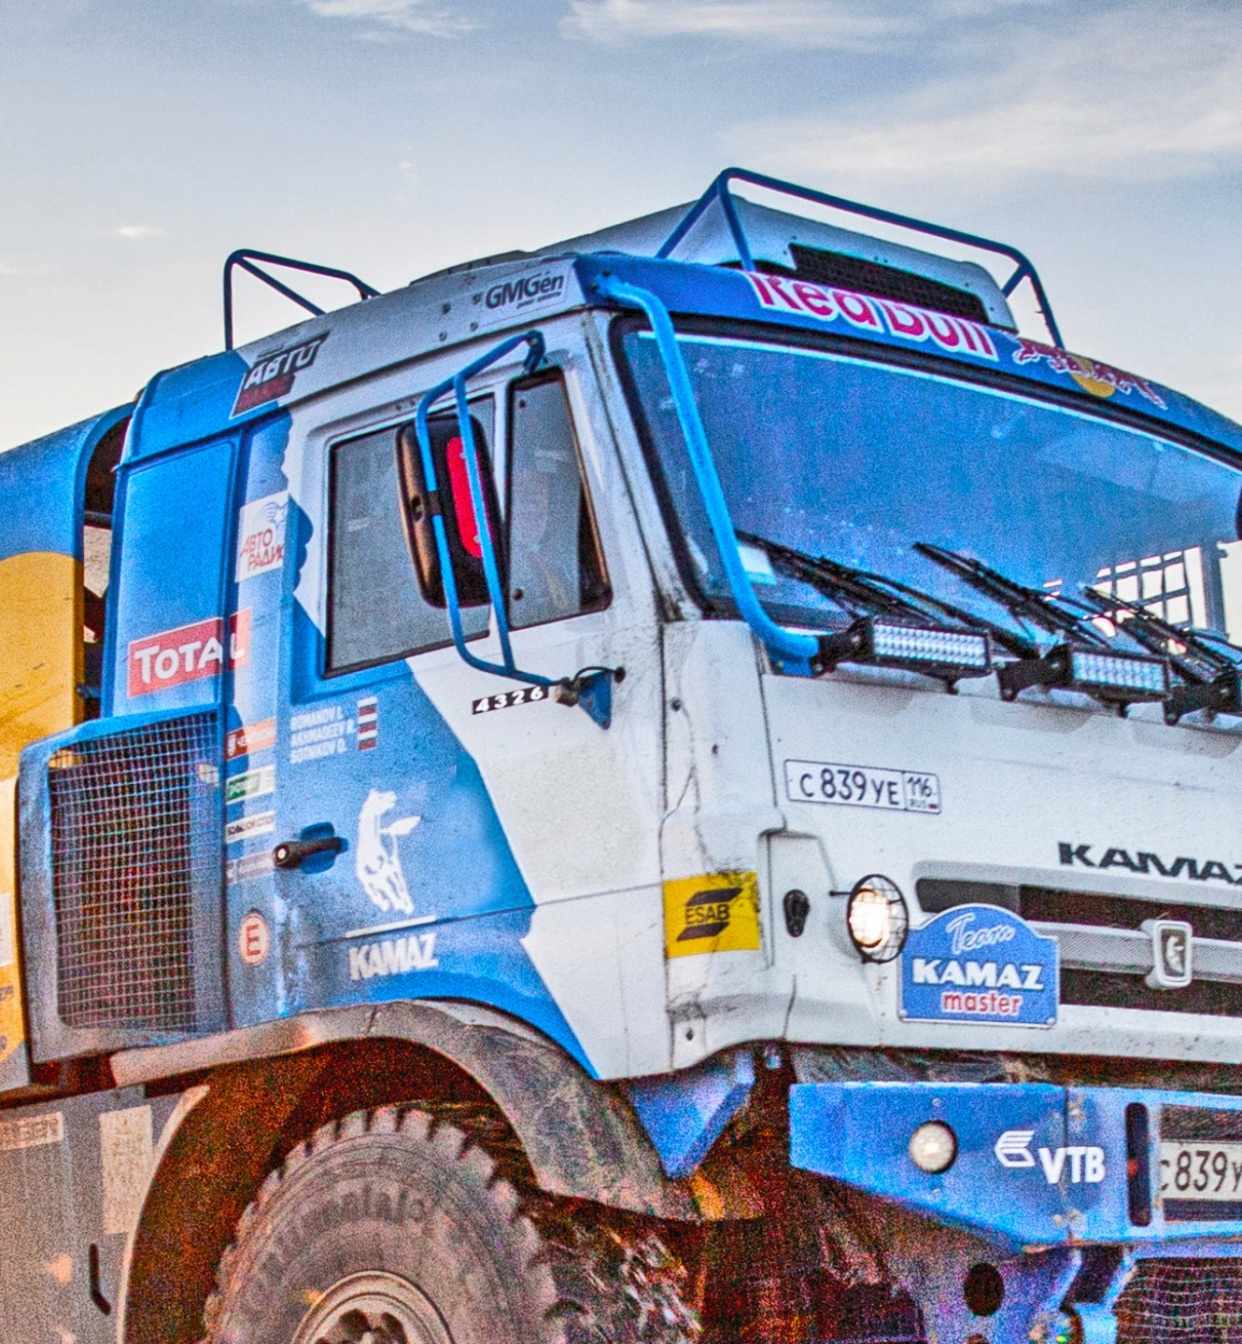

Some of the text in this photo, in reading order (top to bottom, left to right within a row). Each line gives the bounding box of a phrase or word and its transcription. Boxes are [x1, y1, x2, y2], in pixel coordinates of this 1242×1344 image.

[134, 633, 244, 685] TOTAL
[475, 686, 544, 712] 4326
[907, 776, 932, 798] 116
[685, 903, 730, 925] ESAB
[246, 924, 260, 957] E
[946, 912, 1016, 955] Team
[349, 932, 439, 981] KAMAZ
[912, 958, 1044, 990] KAMAZ
[941, 991, 1022, 1016] master
[1039, 1146, 1106, 1184] VTB
